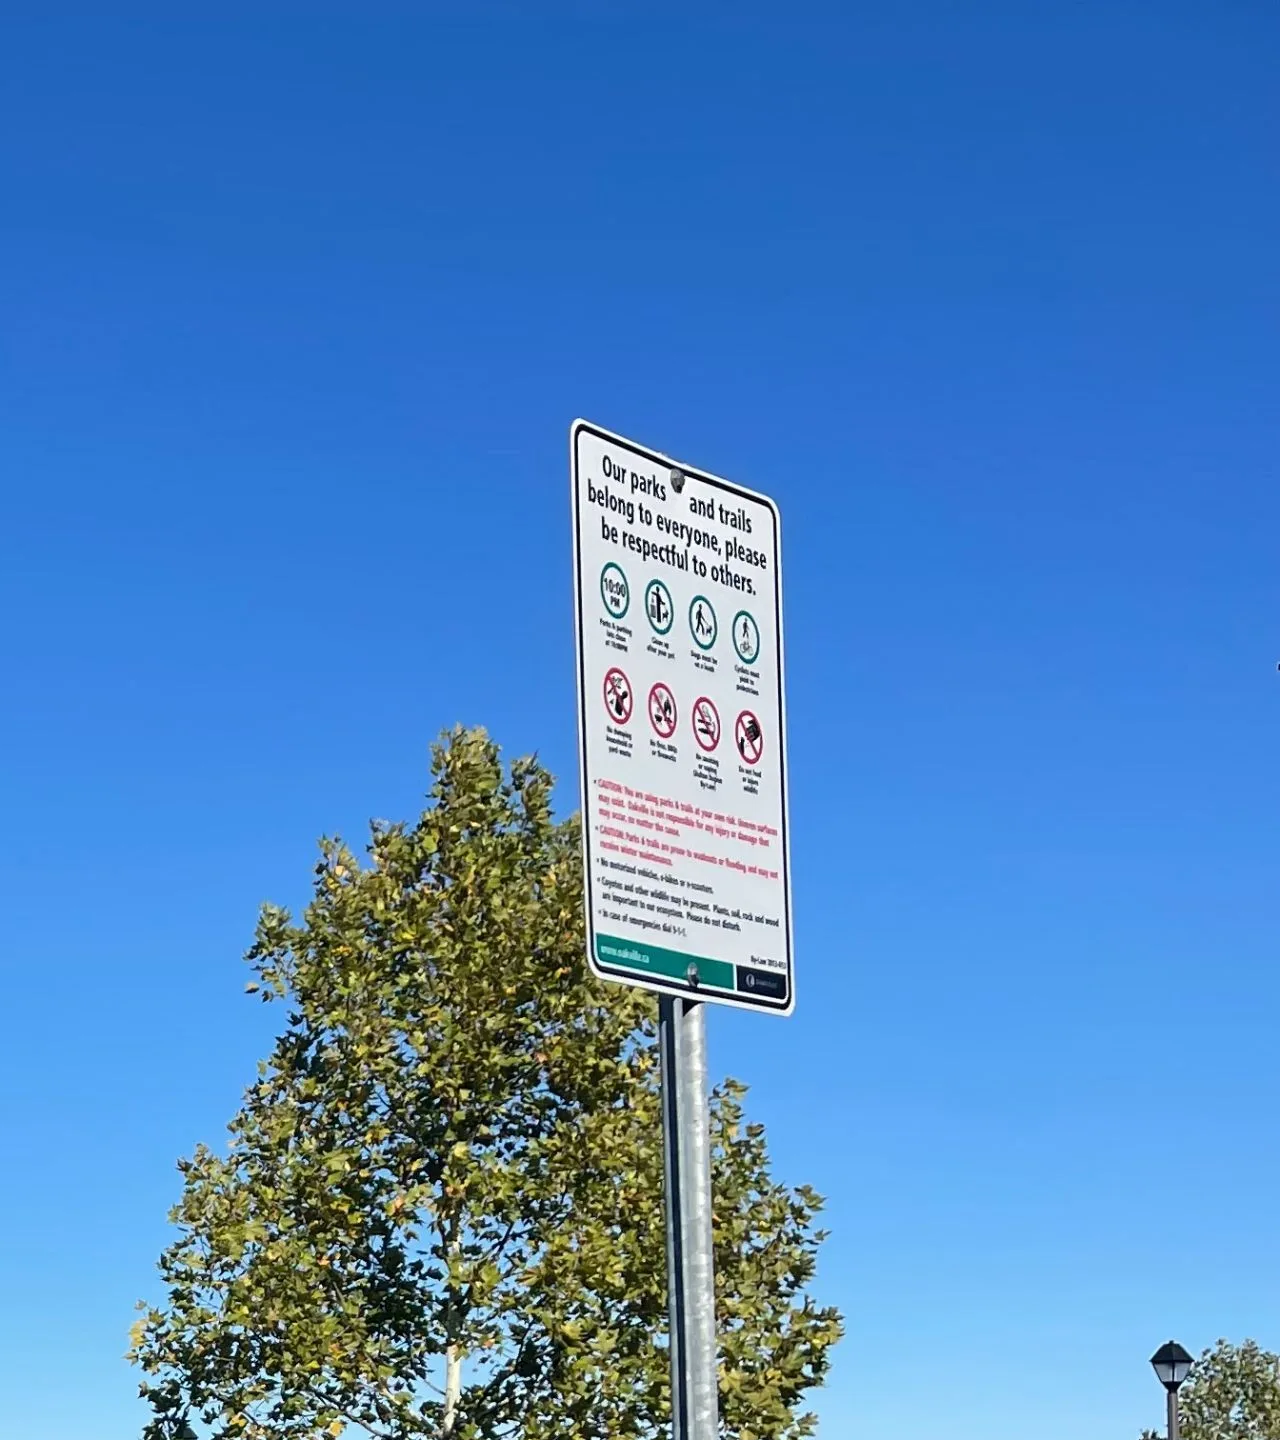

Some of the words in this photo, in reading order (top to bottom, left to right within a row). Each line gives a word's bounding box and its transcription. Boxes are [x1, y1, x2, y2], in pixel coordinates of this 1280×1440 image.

[587, 478, 634, 524] belong
[638, 503, 652, 526] to
[656, 517, 721, 556] everyone,
[725, 537, 767, 569] please
[602, 455, 626, 484] Our
[630, 471, 666, 501] parks
[689, 497, 714, 520] and
[719, 502, 752, 533] trails
[601, 516, 618, 543] be
[622, 531, 688, 572] respectful
[692, 555, 706, 577] to
[711, 564, 756, 595] others.
[604, 578, 626, 597] 10:00
[610, 595, 620, 608] PM
